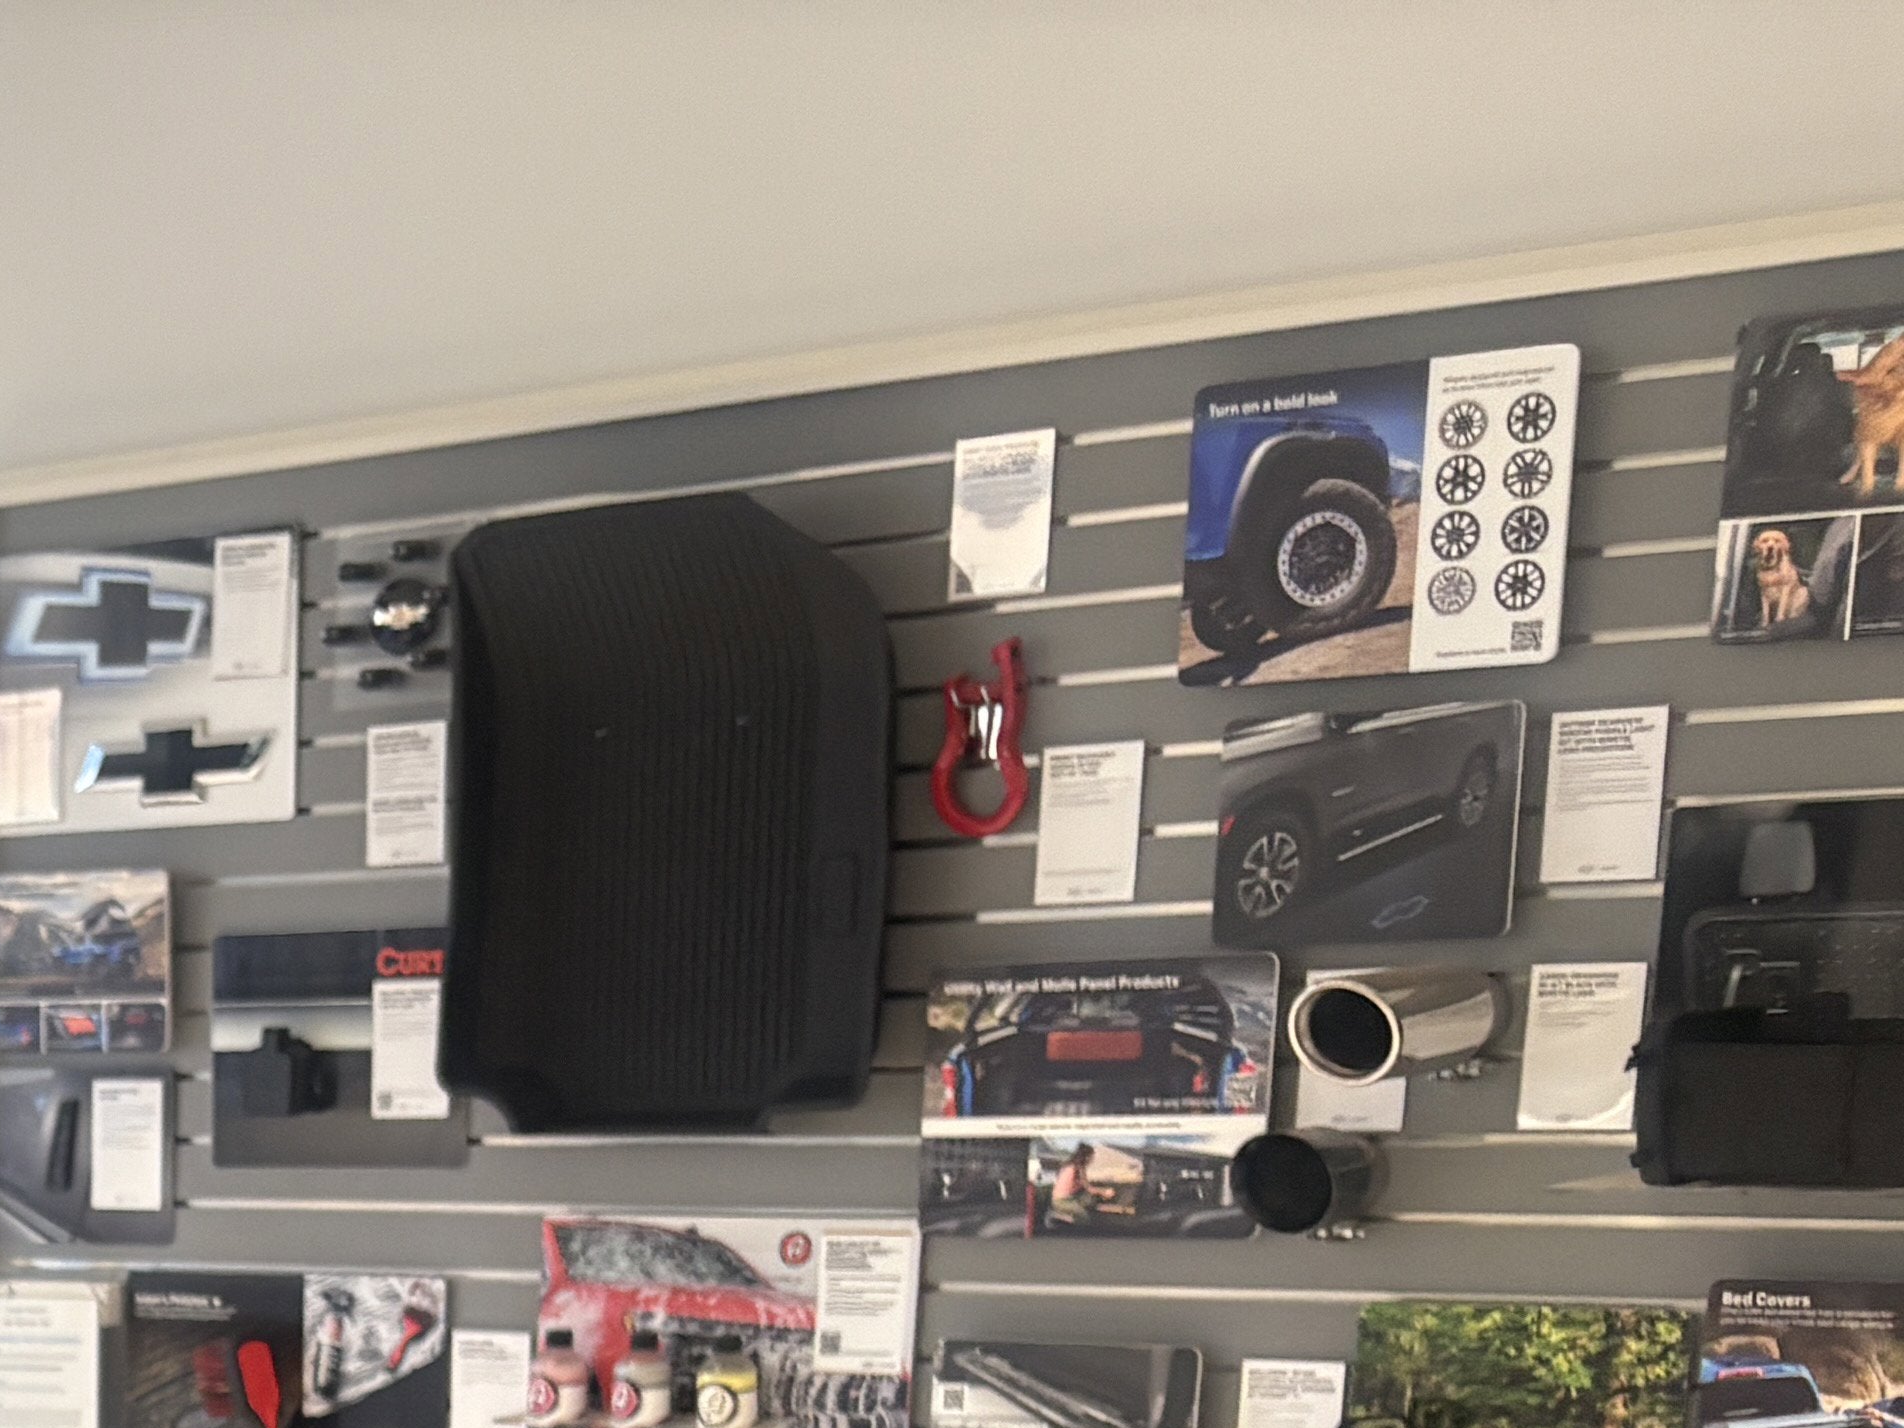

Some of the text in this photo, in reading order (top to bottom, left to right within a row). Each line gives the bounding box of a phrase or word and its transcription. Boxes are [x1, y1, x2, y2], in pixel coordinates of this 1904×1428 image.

[1209, 402, 1240, 418] Turn
[1722, 1291, 1811, 1307] Bed Covers
